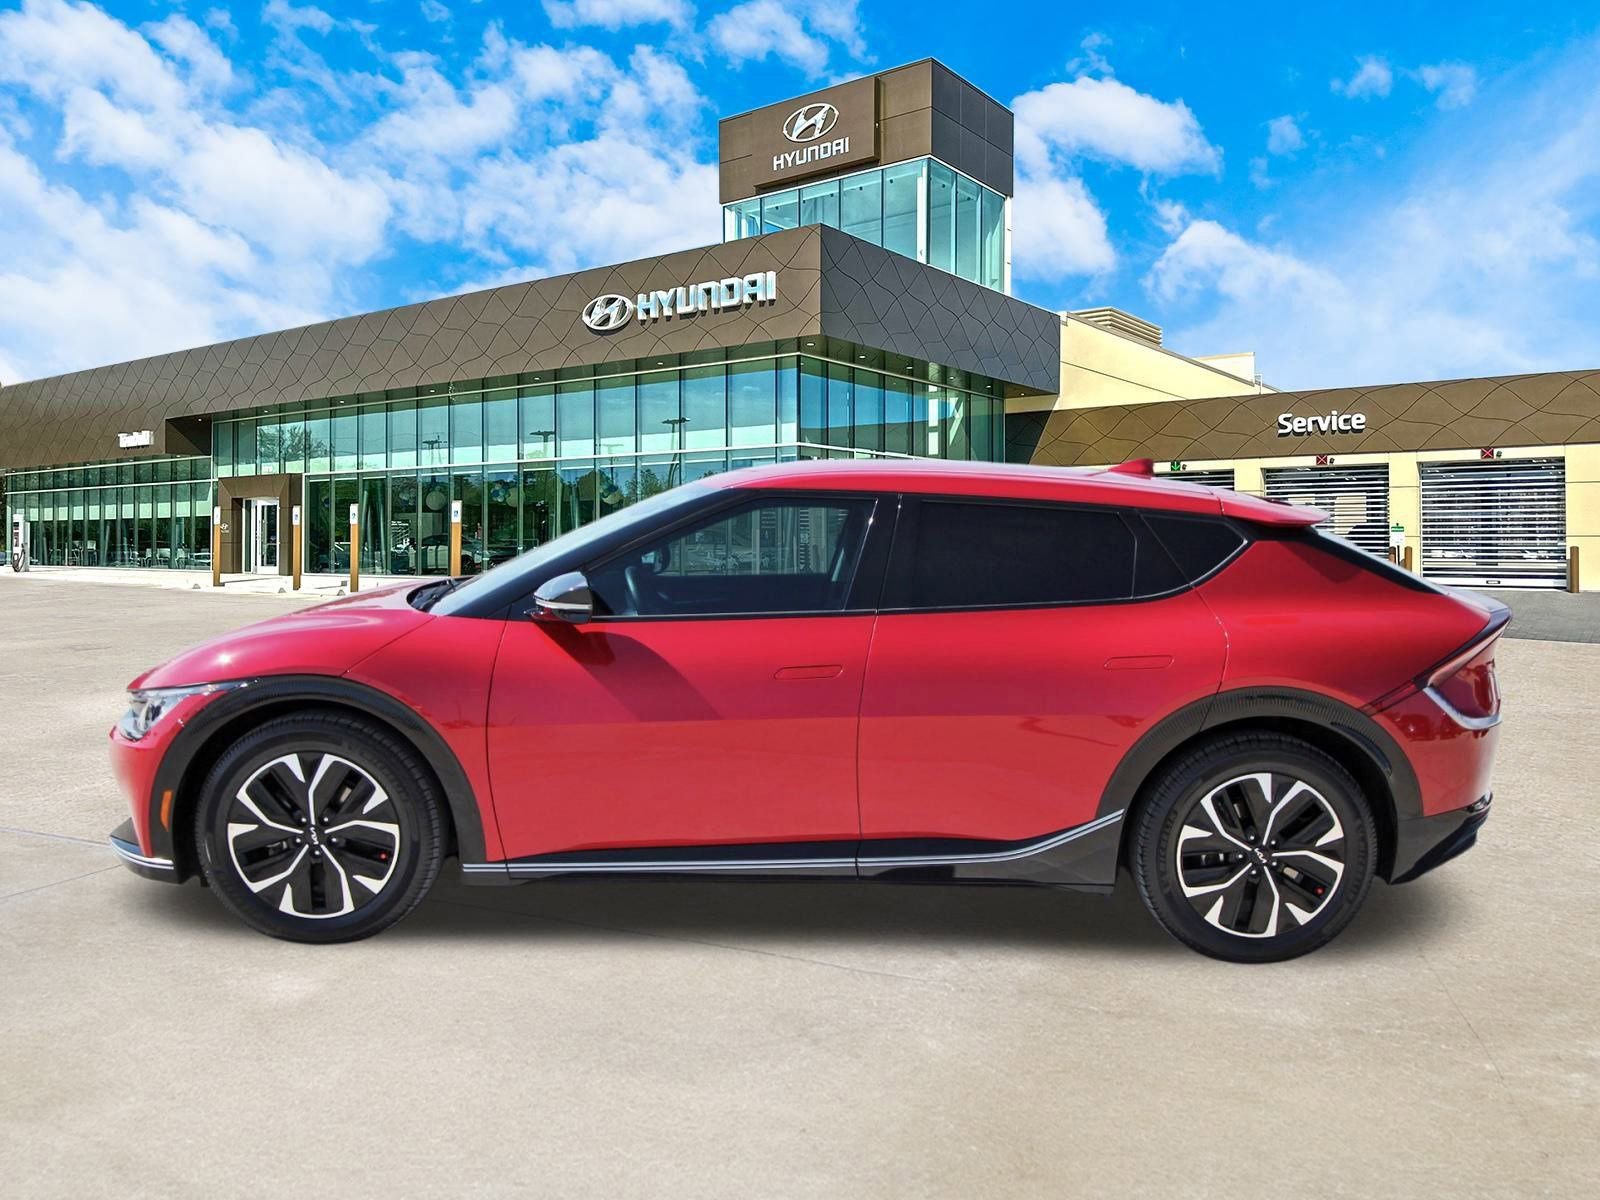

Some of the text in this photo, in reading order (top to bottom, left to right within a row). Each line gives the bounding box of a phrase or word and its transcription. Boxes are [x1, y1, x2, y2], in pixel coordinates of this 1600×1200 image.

[773, 137, 849, 170] HYUNDAI
[637, 271, 777, 320] HYUNDAI
[1277, 410, 1366, 434] Service
